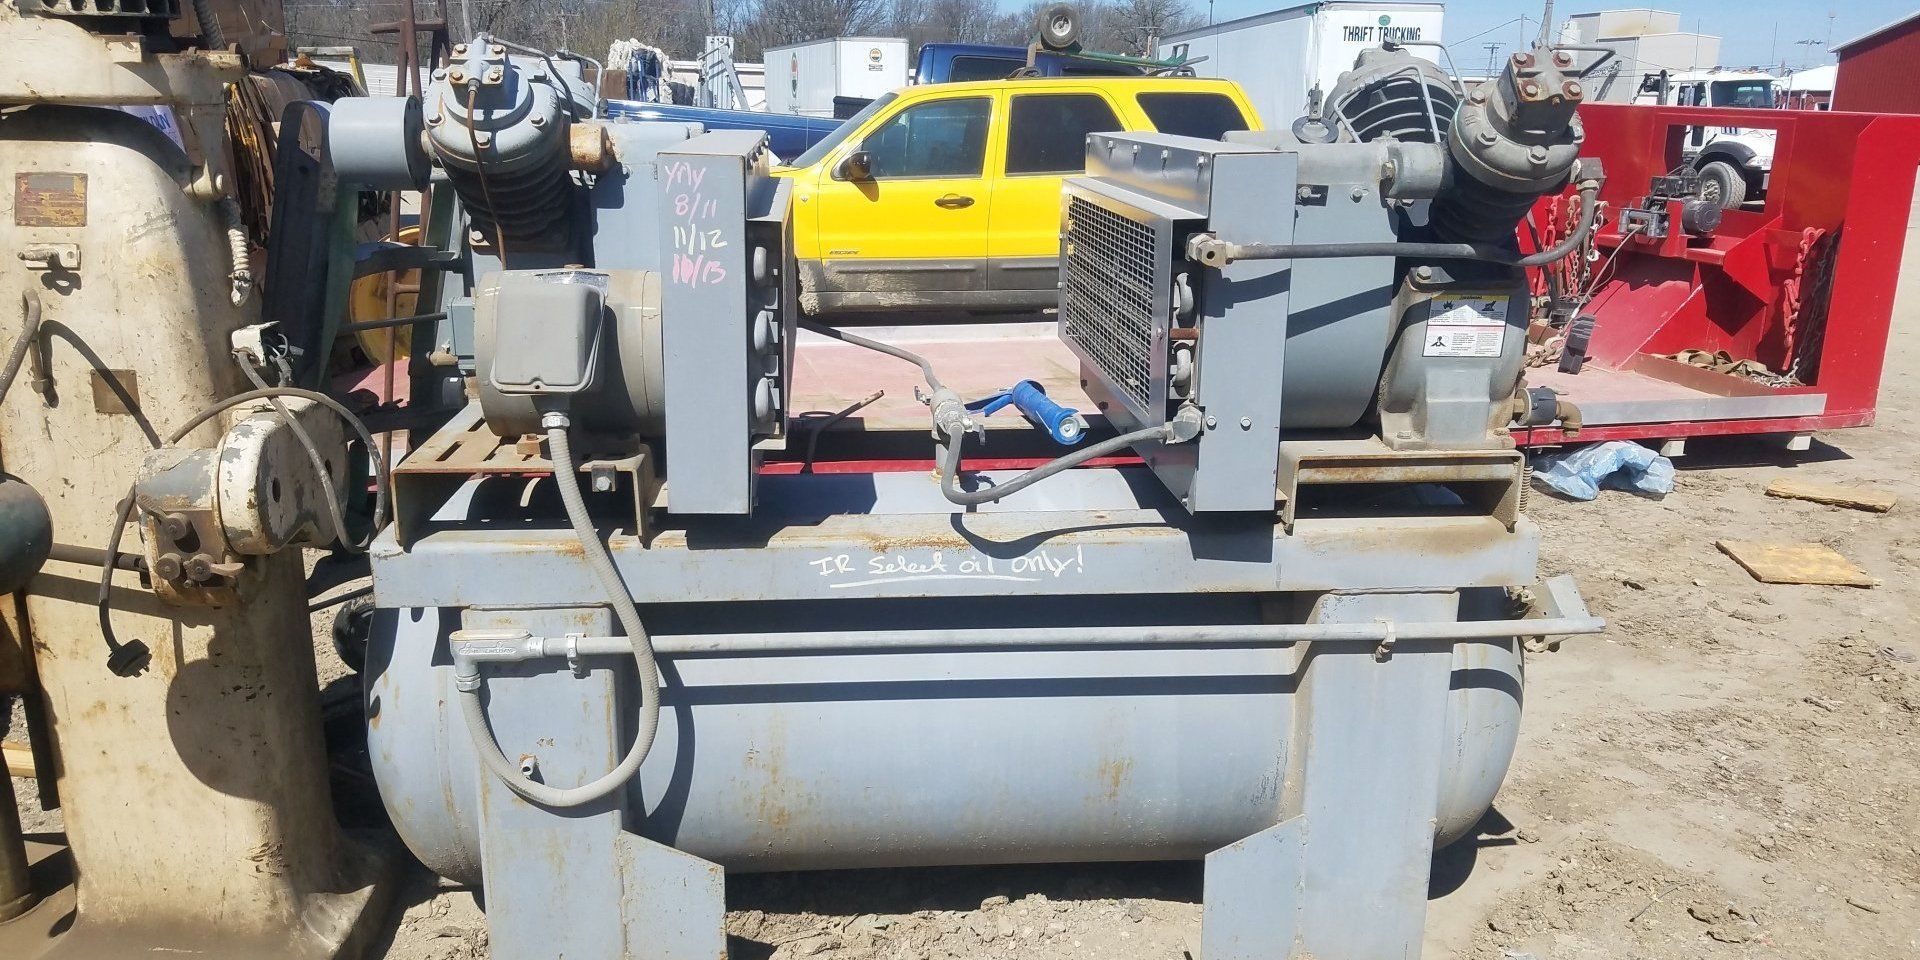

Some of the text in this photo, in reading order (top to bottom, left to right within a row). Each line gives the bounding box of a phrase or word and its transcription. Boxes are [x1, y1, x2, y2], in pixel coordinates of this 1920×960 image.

[1343, 26, 1421, 42] THRIFT TRUCKING
[674, 192, 717, 225] 8/11
[673, 223, 728, 255] 11/12
[809, 554, 856, 577] IR
[959, 553, 996, 574] oil
